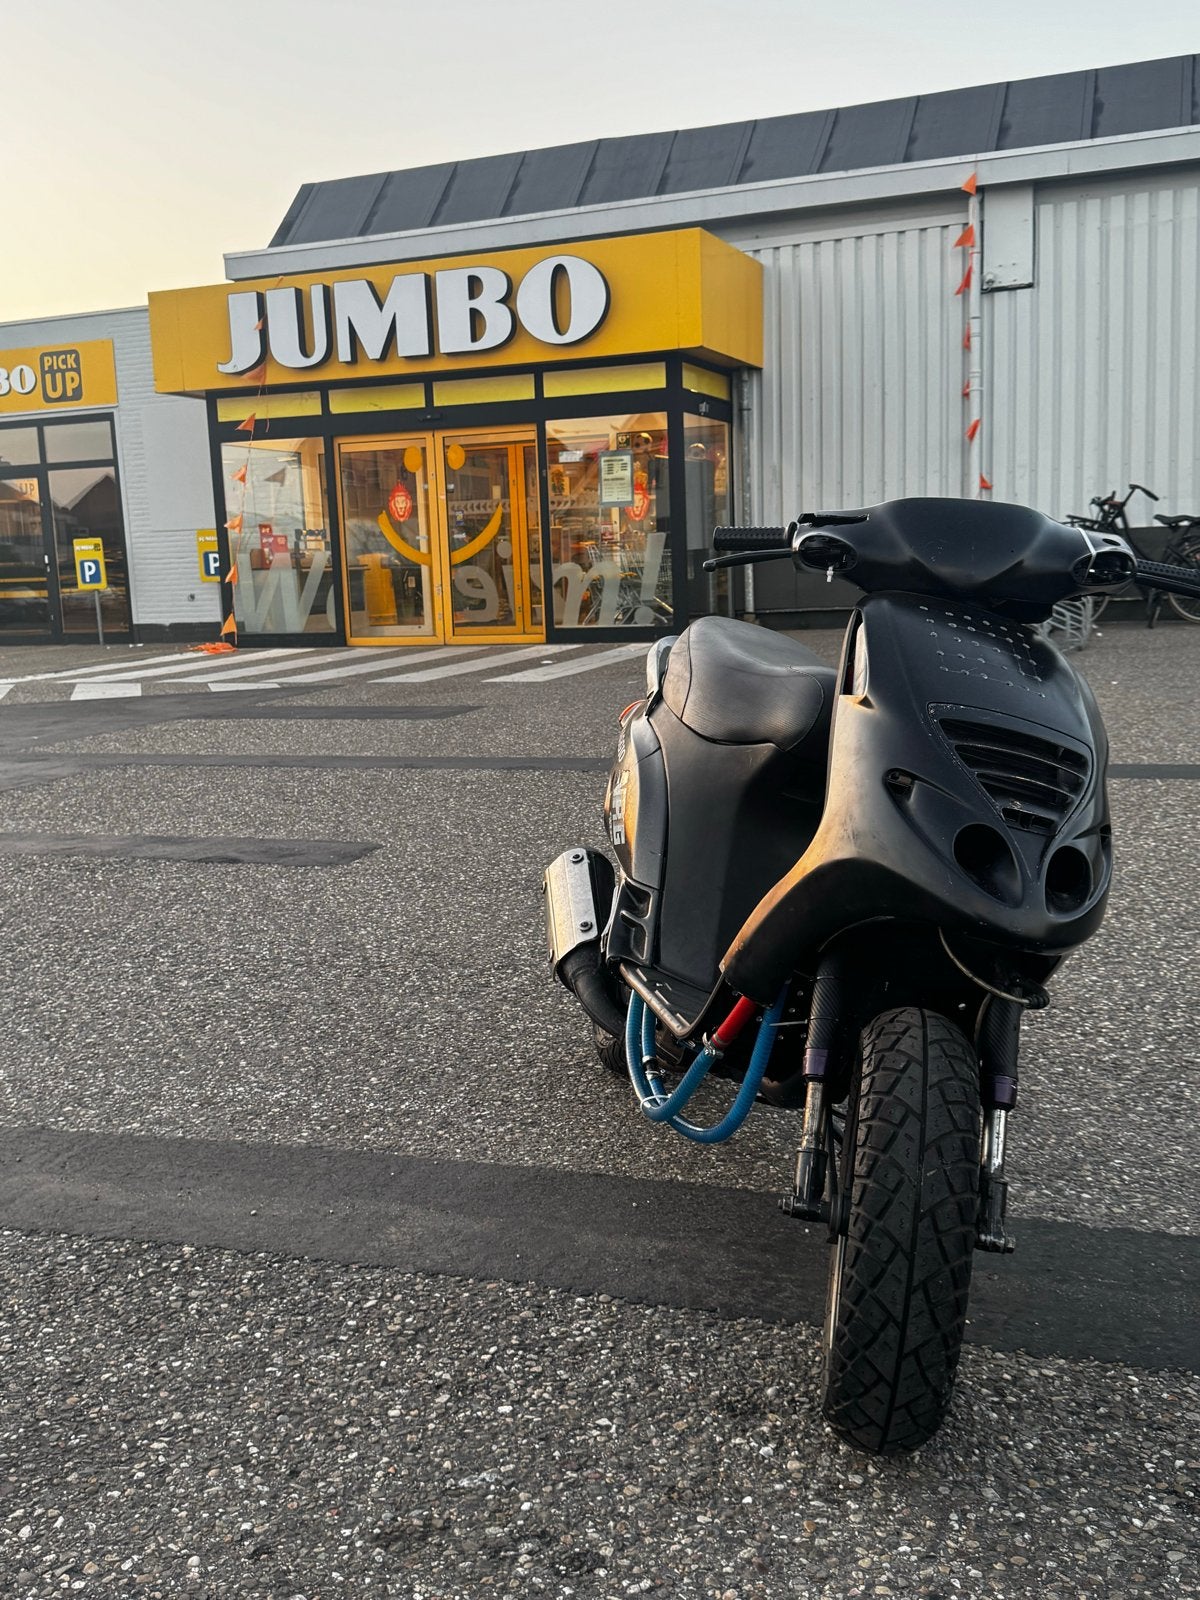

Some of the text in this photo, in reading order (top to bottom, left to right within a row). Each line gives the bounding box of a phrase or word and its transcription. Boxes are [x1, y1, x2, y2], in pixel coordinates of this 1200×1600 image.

[216, 254, 611, 374] JUMBO
[43, 353, 77, 371] PICK
[44, 371, 80, 398] UP
[84, 561, 96, 583] P
